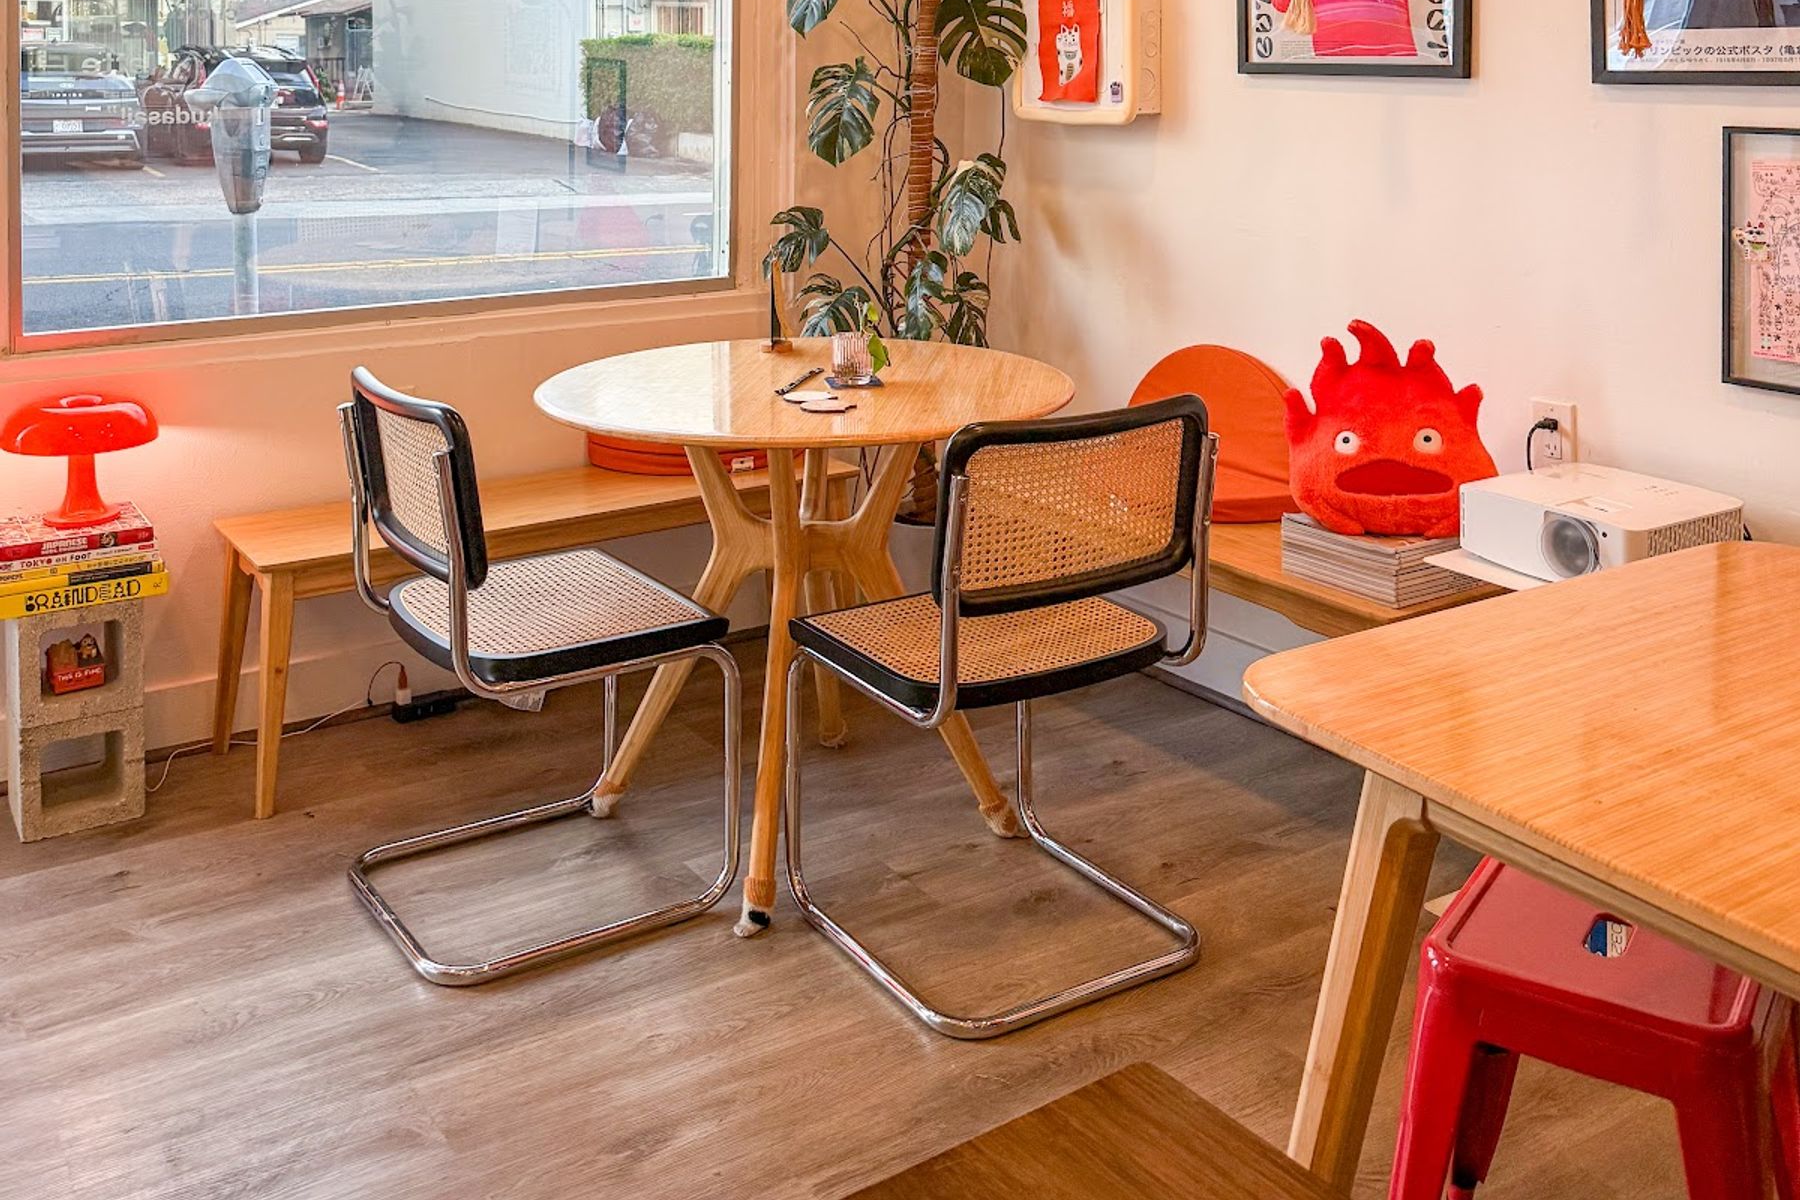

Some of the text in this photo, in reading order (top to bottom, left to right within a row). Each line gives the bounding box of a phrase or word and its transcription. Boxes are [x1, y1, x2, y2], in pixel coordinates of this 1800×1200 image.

[41, 536, 89, 551] JAPANESE
[20, 557, 53, 569] TOKYO
[70, 552, 92, 562] FOOT
